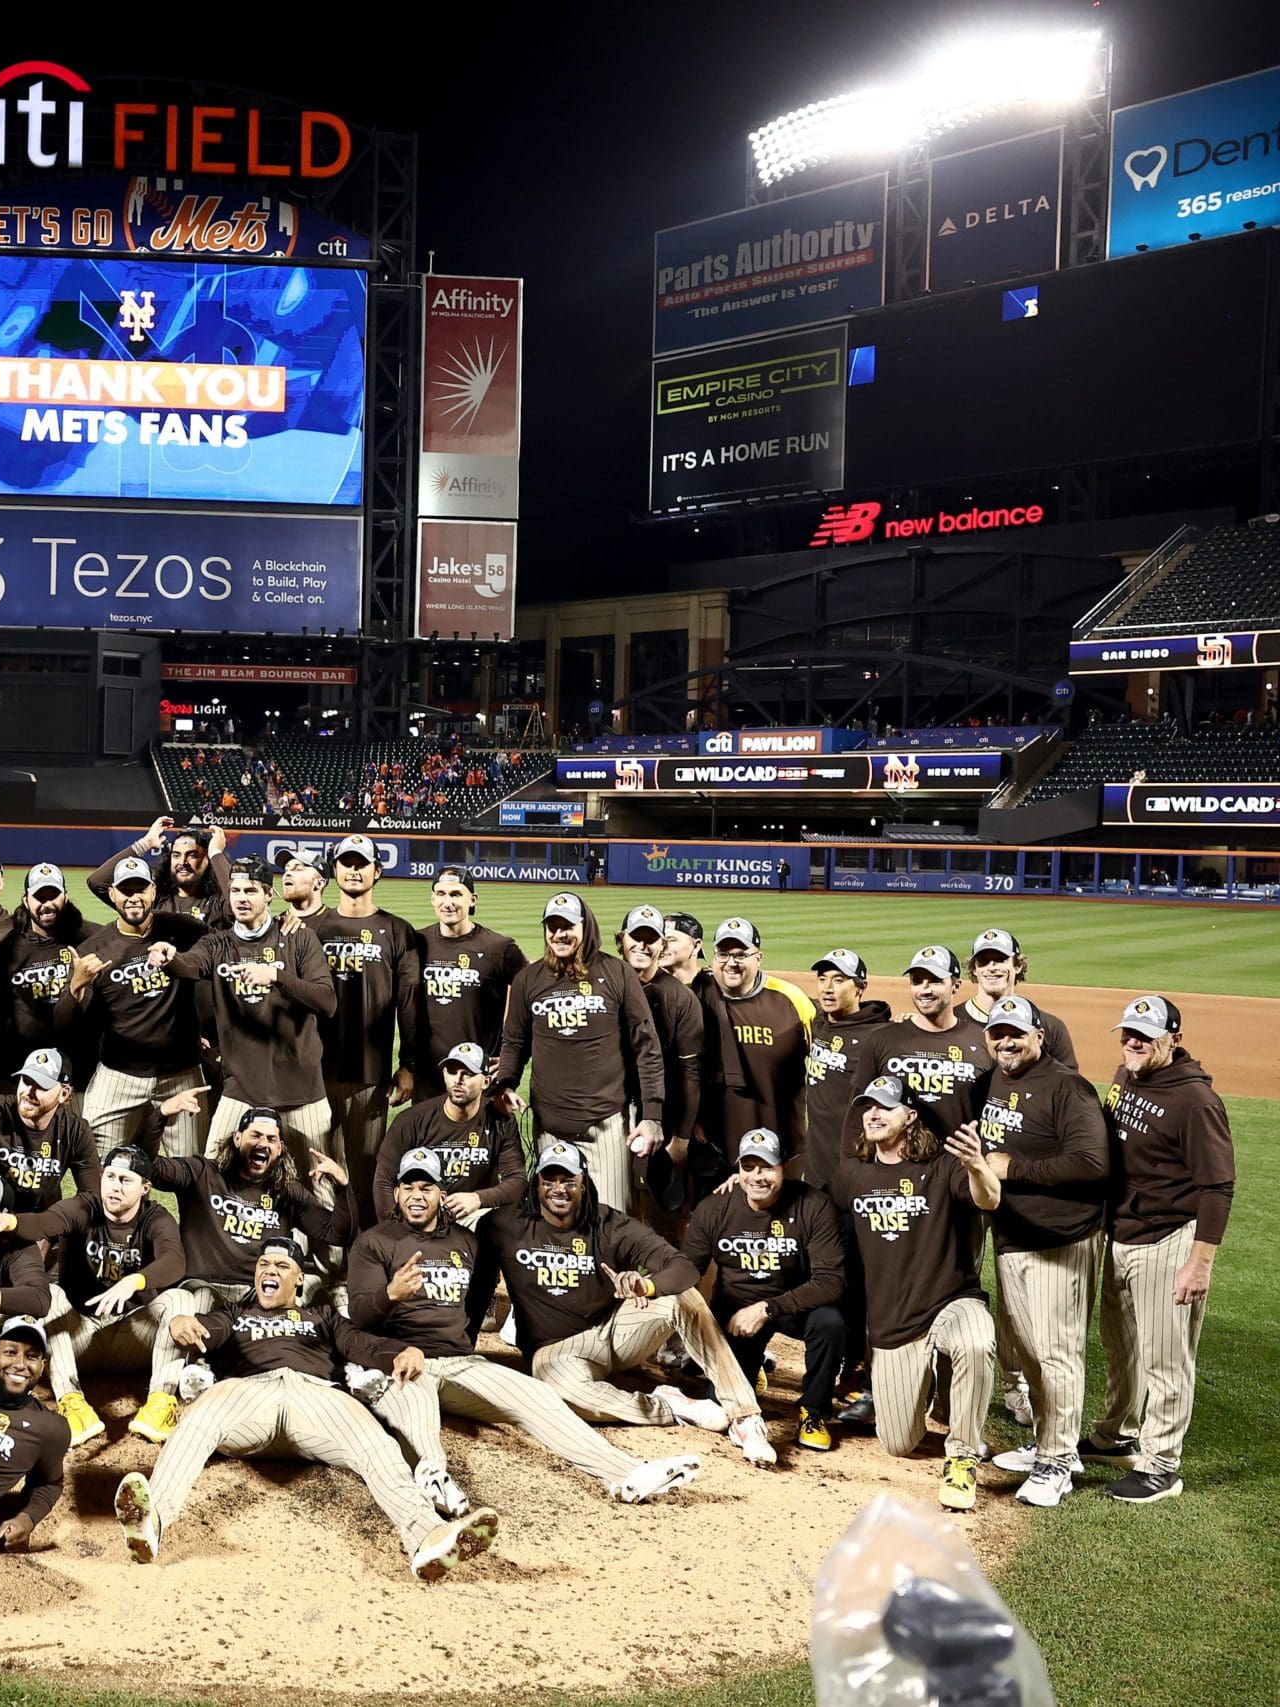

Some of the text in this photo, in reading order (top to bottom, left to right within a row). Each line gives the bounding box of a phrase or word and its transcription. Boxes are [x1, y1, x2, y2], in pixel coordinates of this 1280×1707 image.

[114, 103, 351, 178] FIELD
[1172, 121, 1280, 178] Dent
[1176, 181, 1280, 219] 365 reason
[964, 194, 1052, 230] DELTA
[71, 208, 113, 247] GO
[149, 195, 270, 252] Mets
[317, 239, 347, 257] citi
[658, 219, 875, 296] Parts Authority
[663, 253, 867, 308] Auto Parts Super Stores
[431, 288, 515, 318] Affinity
[721, 292, 778, 314] Answer
[176, 369, 282, 408] YOU
[667, 361, 828, 403] EMPIRE CITY
[715, 388, 775, 408] CASINO
[708, 404, 782, 424] BY MGM RESORTS
[21, 408, 249, 449] METS FANS
[662, 431, 831, 474] IT'S A HOME RUN
[448, 476, 508, 498] Affinity
[884, 504, 1045, 539] new balance
[31, 536, 233, 601] Tezos
[252, 560, 327, 573] A Blockchain
[427, 556, 505, 577] Jake's 58
[252, 576, 328, 592] to Build, Play
[428, 576, 472, 585] Casino Hotel
[252, 592, 326, 605] & Collect on.
[109, 613, 153, 625] tezos.nyc
[1101, 648, 1170, 661] SAN DIEGO
[167, 667, 346, 681] THE JIM BEAM BOURBON BAR
[159, 700, 227, 715] Coors LIGHT
[705, 734, 817, 754] citi PAVILION
[695, 766, 734, 782] WILD
[734, 766, 777, 782] CARD
[927, 767, 981, 777] NEW YORK
[502, 803, 582, 812] BULLPEN JACKPOT IS
[1169, 796, 1273, 813] WILD CARD
[202, 812, 265, 828] Coors LIGHT
[290, 814, 352, 829] Coors LIGHT
[379, 815, 442, 831] Coors LIGHT
[502, 813, 521, 822] NOW
[409, 862, 435, 878] 380
[466, 865, 580, 883] KONICA MINOLTA
[646, 856, 773, 873] DRAFTKINGS
[675, 872, 772, 886] SPORTSBOOK
[833, 879, 865, 889] workday
[886, 880, 918, 890] workday
[940, 881, 971, 891] workday
[984, 876, 1014, 891] 370
[327, 956, 364, 974] RISE
[132, 974, 171, 996] RISE
[426, 981, 463, 998] RISE
[531, 994, 608, 1015] OCTOBER
[547, 1009, 589, 1030] RISE
[886, 1056, 977, 1080] OCTOBER
[907, 1071, 955, 1095] RISE
[1135, 1095, 1166, 1119] DIEGO
[980, 1119, 1007, 1145] RISE
[209, 1193, 281, 1227] OCTOBER
[853, 1195, 929, 1214] OCTOBER
[222, 1215, 265, 1241] RISE
[869, 1211, 911, 1232] RISE
[717, 1237, 799, 1254] OCTOBER
[515, 1248, 596, 1272] OCTOBER
[739, 1252, 782, 1271] RISE
[537, 1266, 582, 1289] RISE
[422, 1281, 462, 1303] RISE
[231, 1315, 317, 1335] OCTOBER
